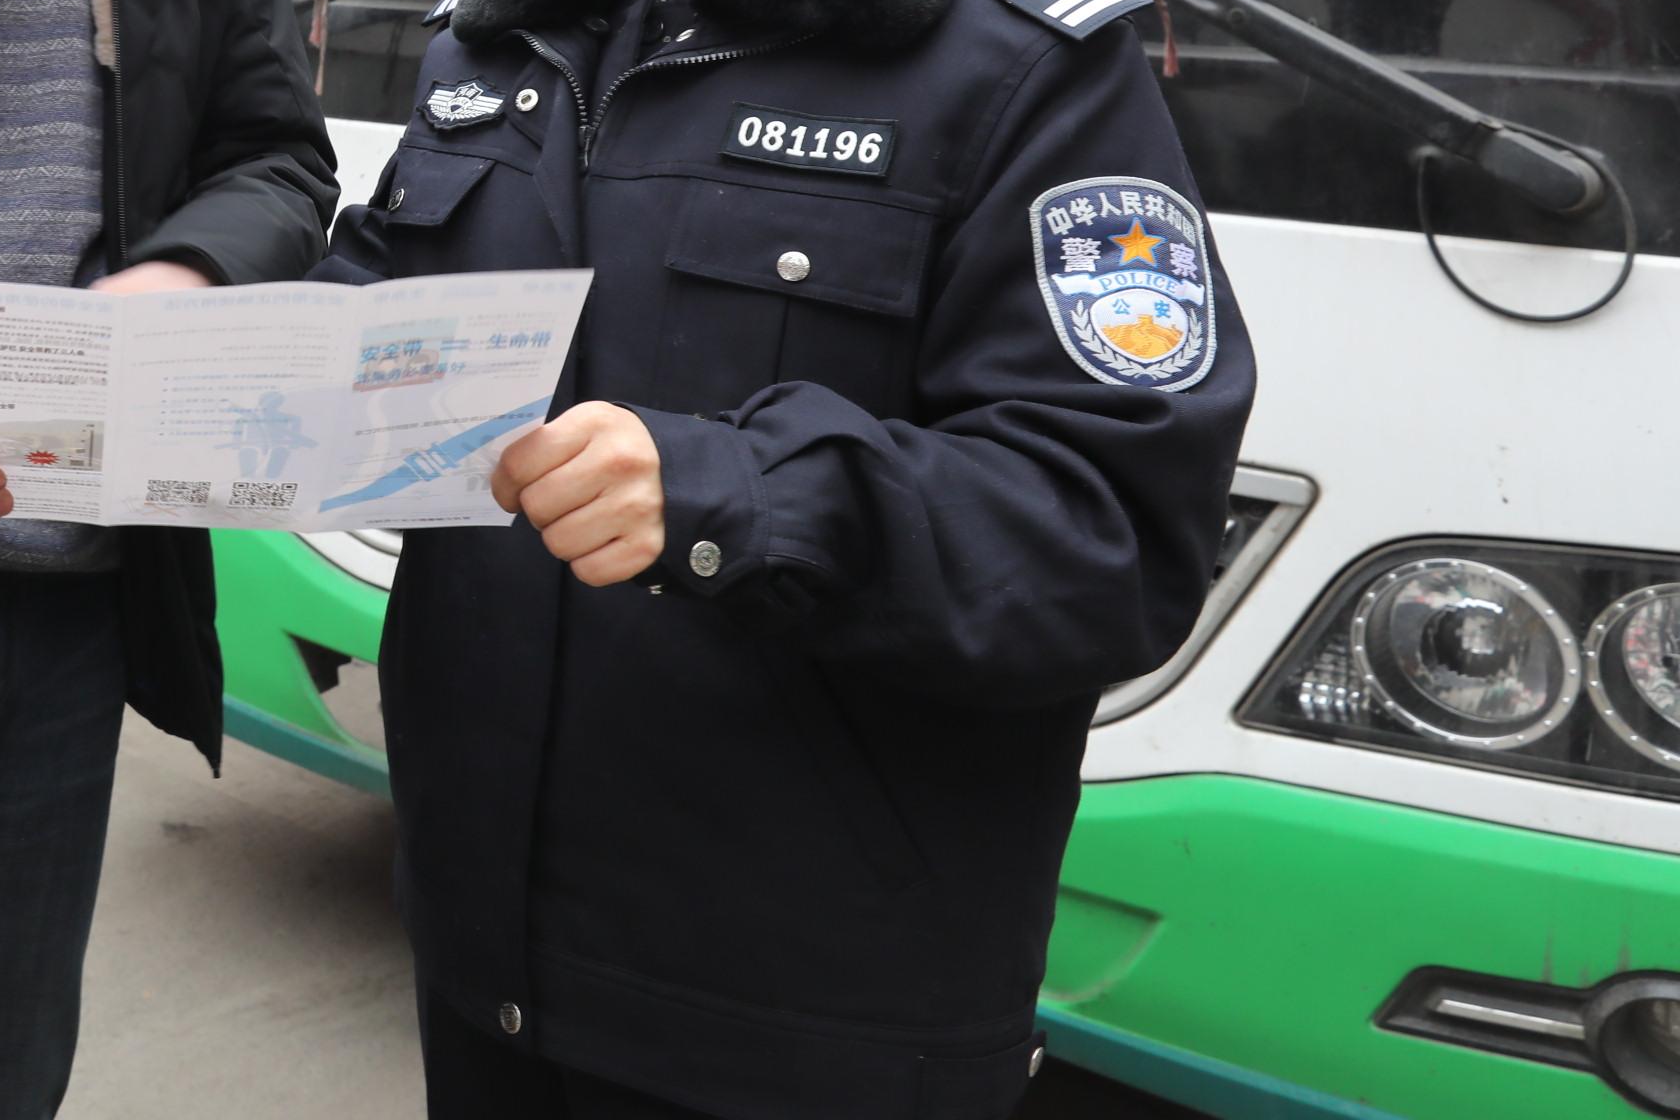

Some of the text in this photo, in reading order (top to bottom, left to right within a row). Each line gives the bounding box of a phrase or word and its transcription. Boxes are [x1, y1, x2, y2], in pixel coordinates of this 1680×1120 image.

[737, 116, 884, 164] 081196
[1045, 191, 1197, 247] 中华人民共和国
[1098, 271, 1179, 295] POLICE
[361, 339, 424, 364] 安全带
[486, 330, 552, 350] 生命带
